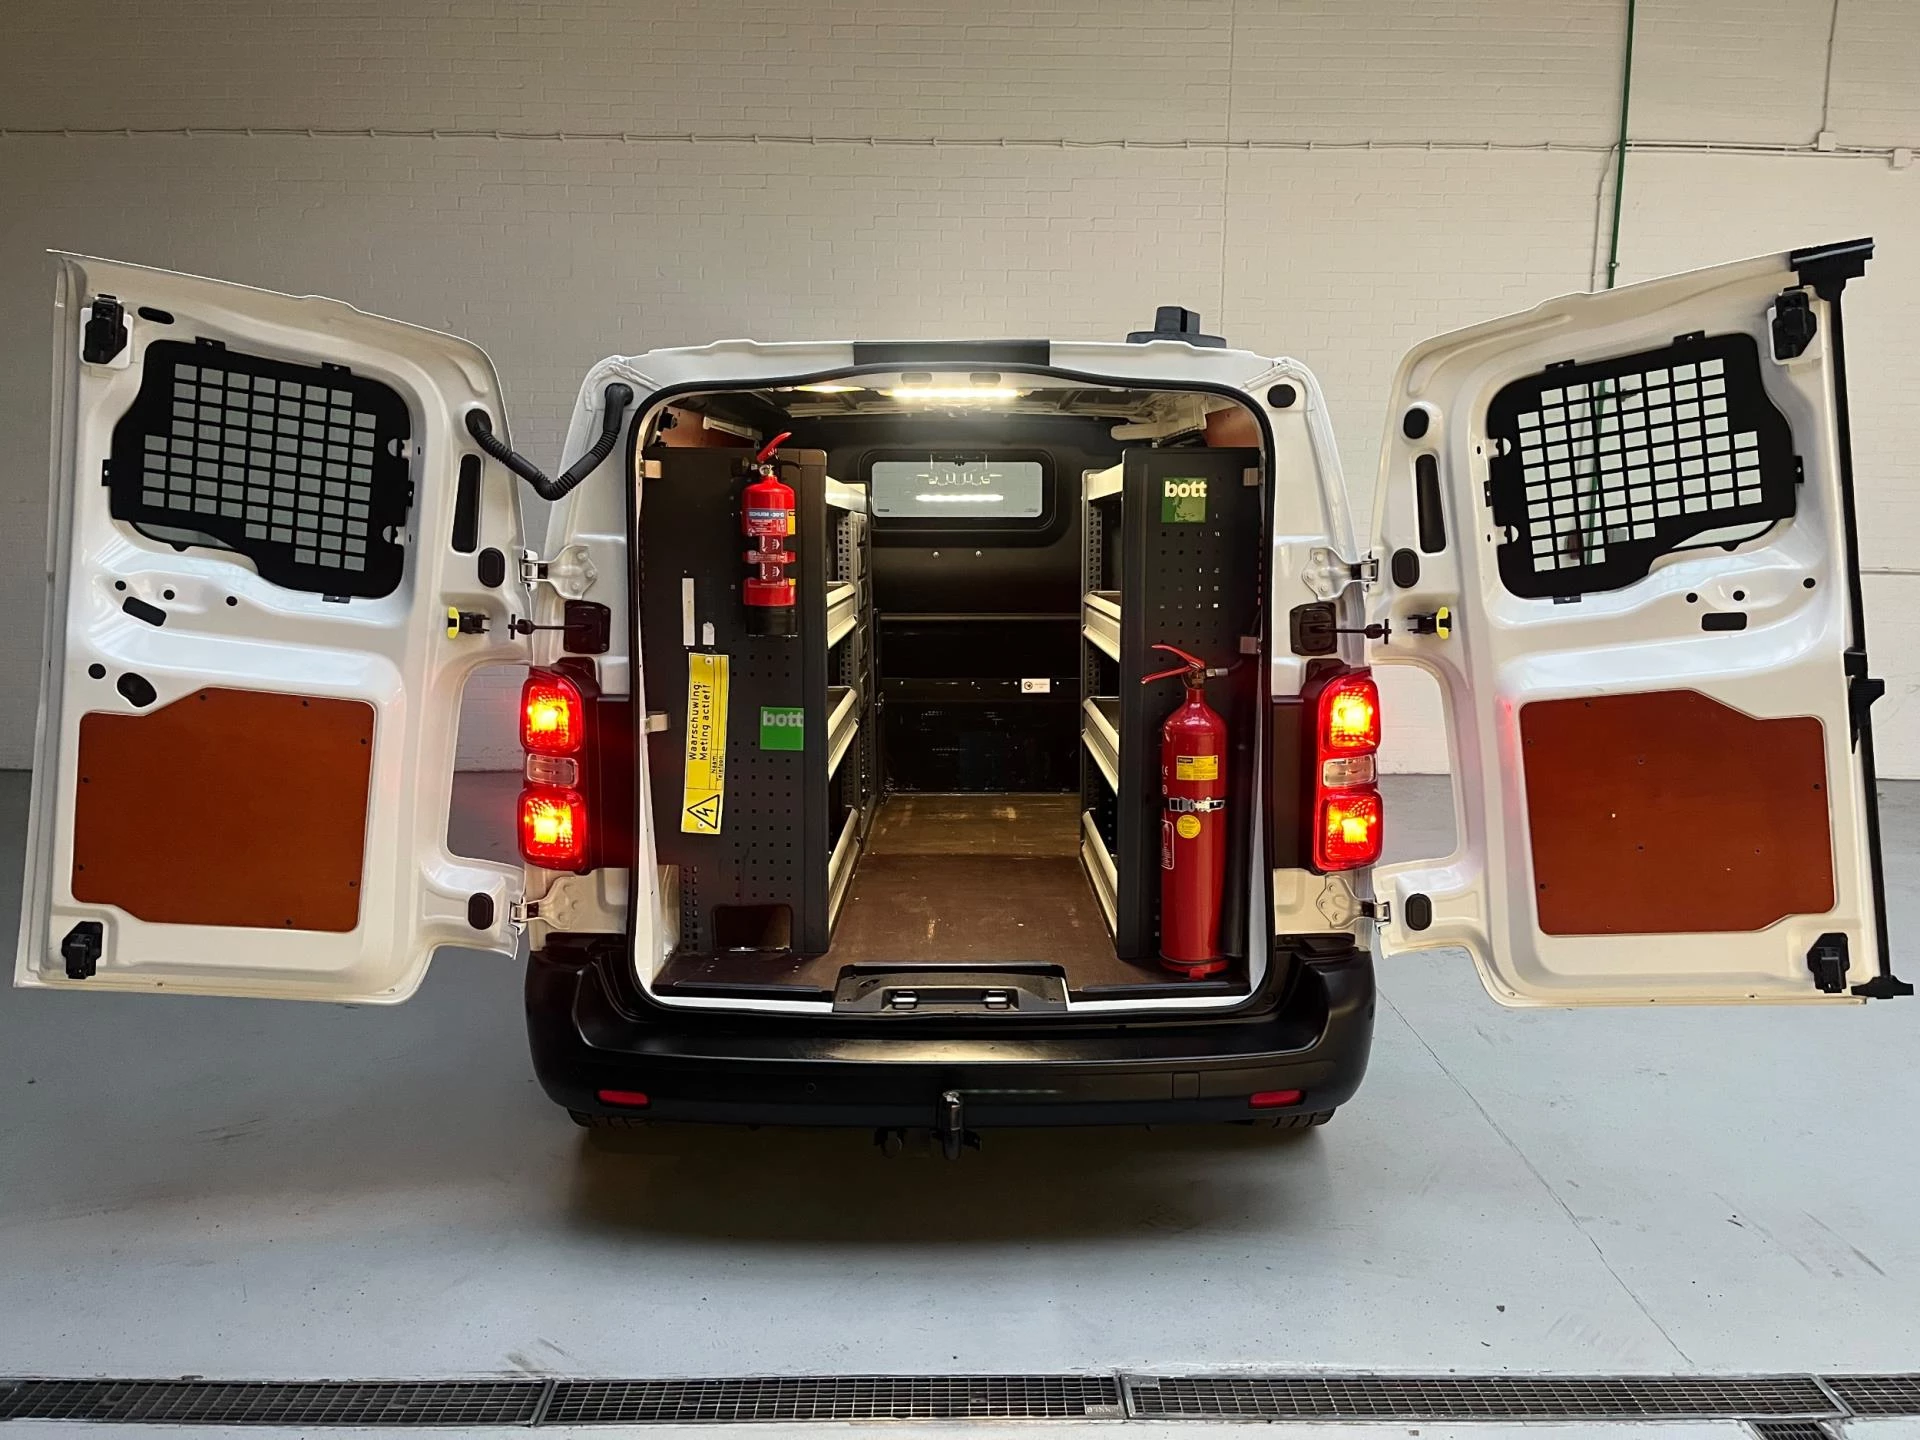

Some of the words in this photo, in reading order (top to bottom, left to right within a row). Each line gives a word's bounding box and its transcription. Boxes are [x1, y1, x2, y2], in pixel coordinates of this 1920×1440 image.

[1165, 481, 1207, 497] bott
[763, 711, 803, 727] bott
[699, 724, 711, 761] Meting
